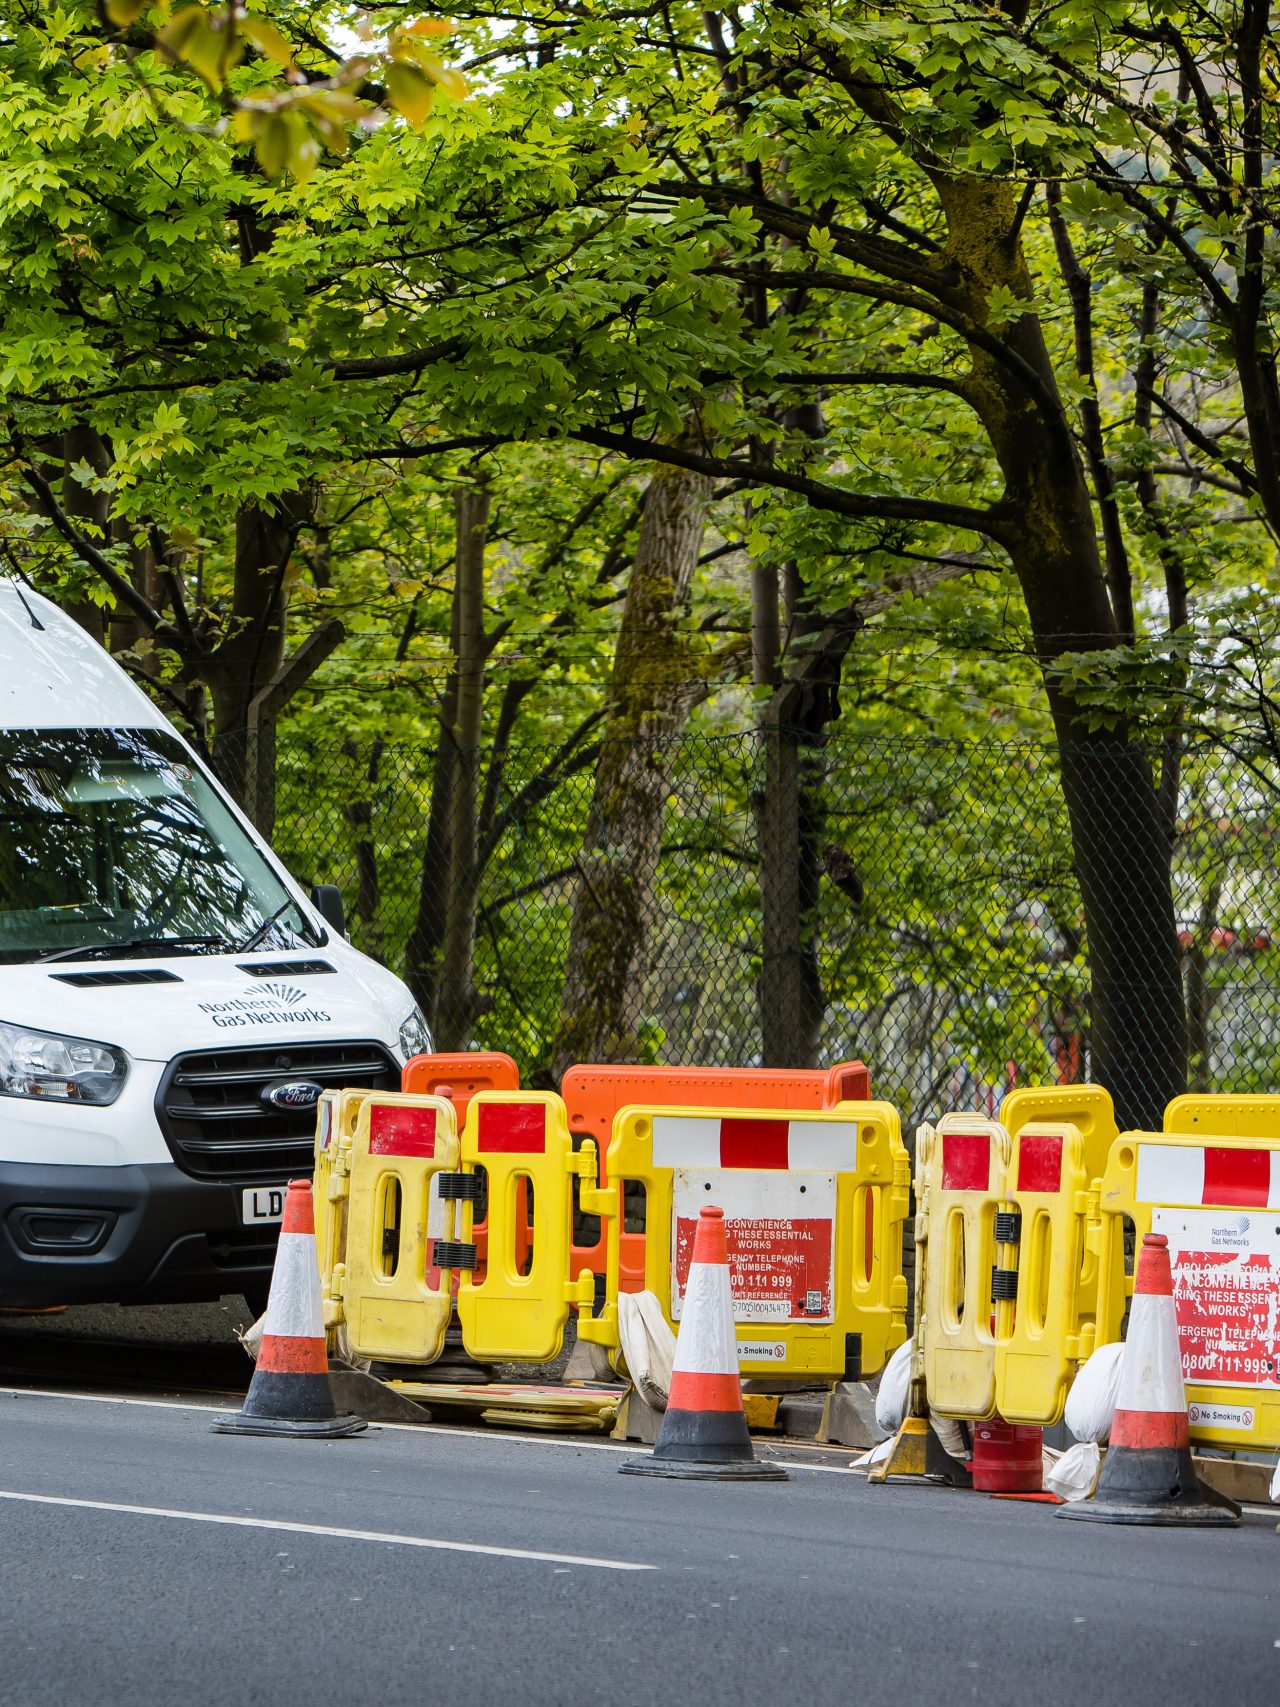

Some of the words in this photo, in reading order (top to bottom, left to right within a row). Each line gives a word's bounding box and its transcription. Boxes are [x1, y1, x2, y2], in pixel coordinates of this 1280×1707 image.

[198, 1000, 282, 1014] Northern
[212, 1014, 246, 1028] Gas
[245, 1008, 332, 1025] Networks
[285, 1086, 316, 1103] Ford
[253, 1190, 285, 1218] LD
[724, 1220, 793, 1230] CONVENIENCE
[733, 1230, 762, 1239] THESE
[764, 1230, 814, 1241] ESSENTIAL
[1211, 1227, 1237, 1237] Northern
[737, 1240, 772, 1249] WORKS
[1211, 1237, 1222, 1245] Gas
[1222, 1237, 1250, 1247] Networks
[727, 1254, 754, 1262] GENCY
[756, 1254, 805, 1263] TELEPHONE
[736, 1263, 772, 1272] NUMBER
[731, 1275, 744, 1286] 00
[748, 1274, 767, 1286] 111
[771, 1275, 792, 1287] 999
[1175, 1289, 1201, 1301] RING
[1202, 1290, 1236, 1303] THESE
[1238, 1292, 1272, 1304] ESSEN
[1208, 1304, 1246, 1317] WORKS
[744, 1347, 773, 1356] Smoking
[1183, 1354, 1212, 1370] 0800
[1217, 1356, 1240, 1373] 111
[1244, 1357, 1267, 1374] 999
[1201, 1410, 1211, 1419] No
[1212, 1411, 1241, 1423] Smoking
